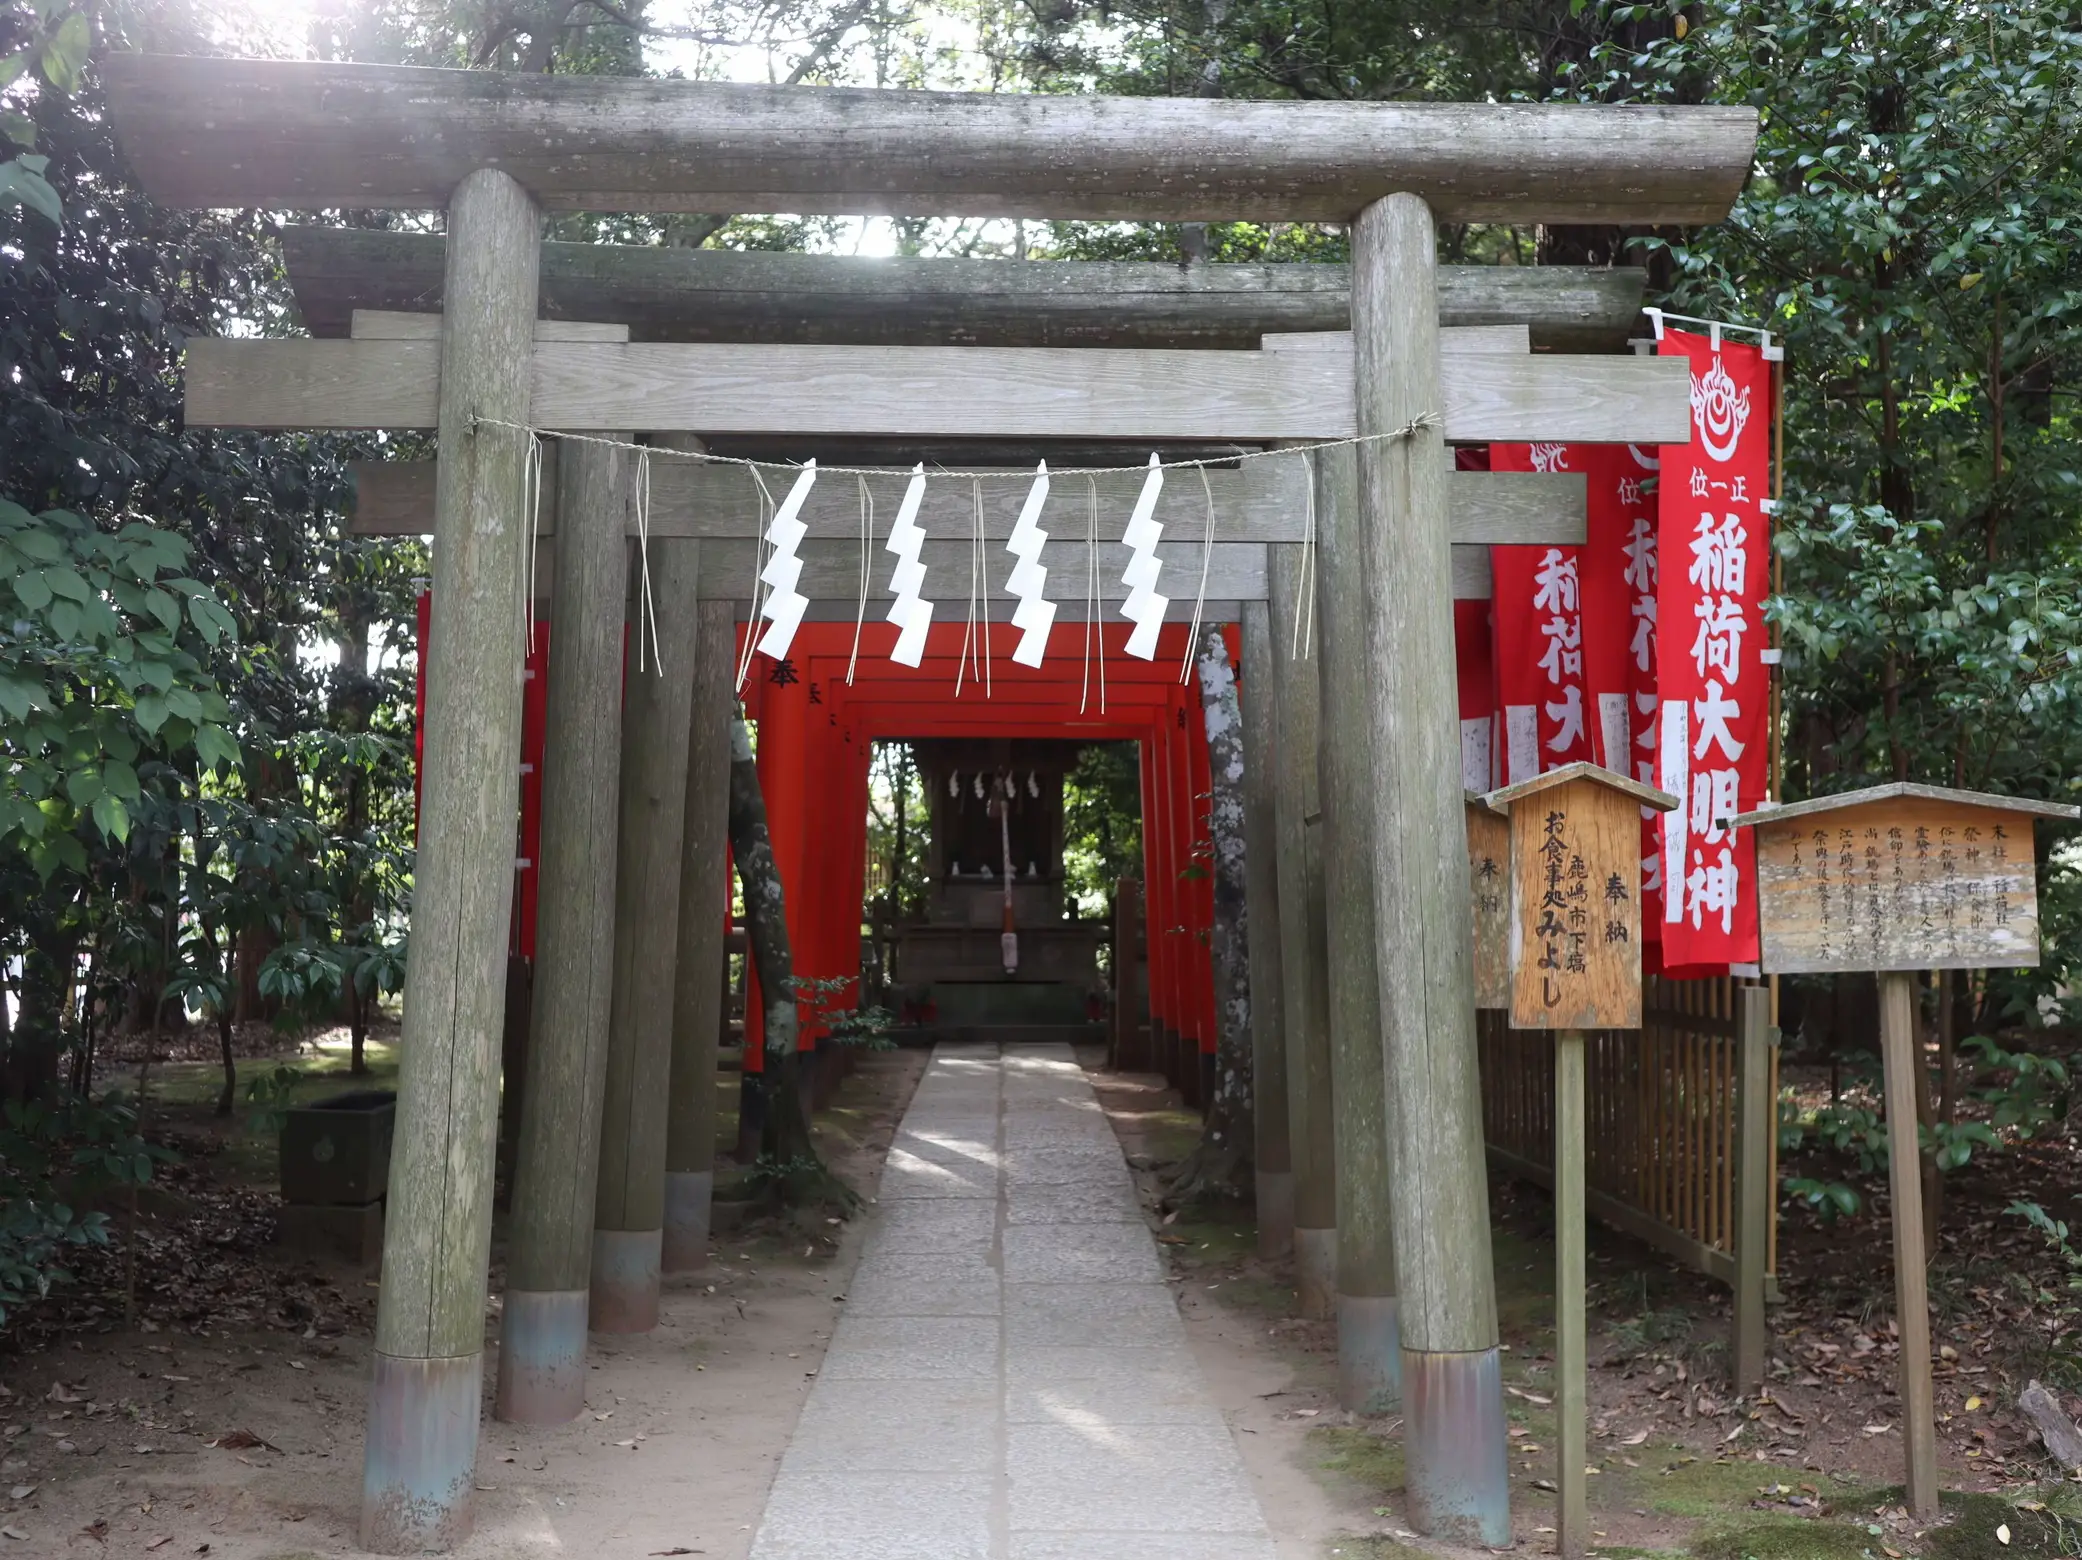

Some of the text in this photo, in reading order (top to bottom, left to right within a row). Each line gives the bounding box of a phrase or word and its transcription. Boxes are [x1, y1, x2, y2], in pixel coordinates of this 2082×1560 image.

[1686, 512, 1748, 935] 稲荷大明神
[1477, 857, 1500, 913] 奉納
[1536, 811, 1568, 1008] お食事処みよし
[1604, 872, 1628, 943] 奉納
